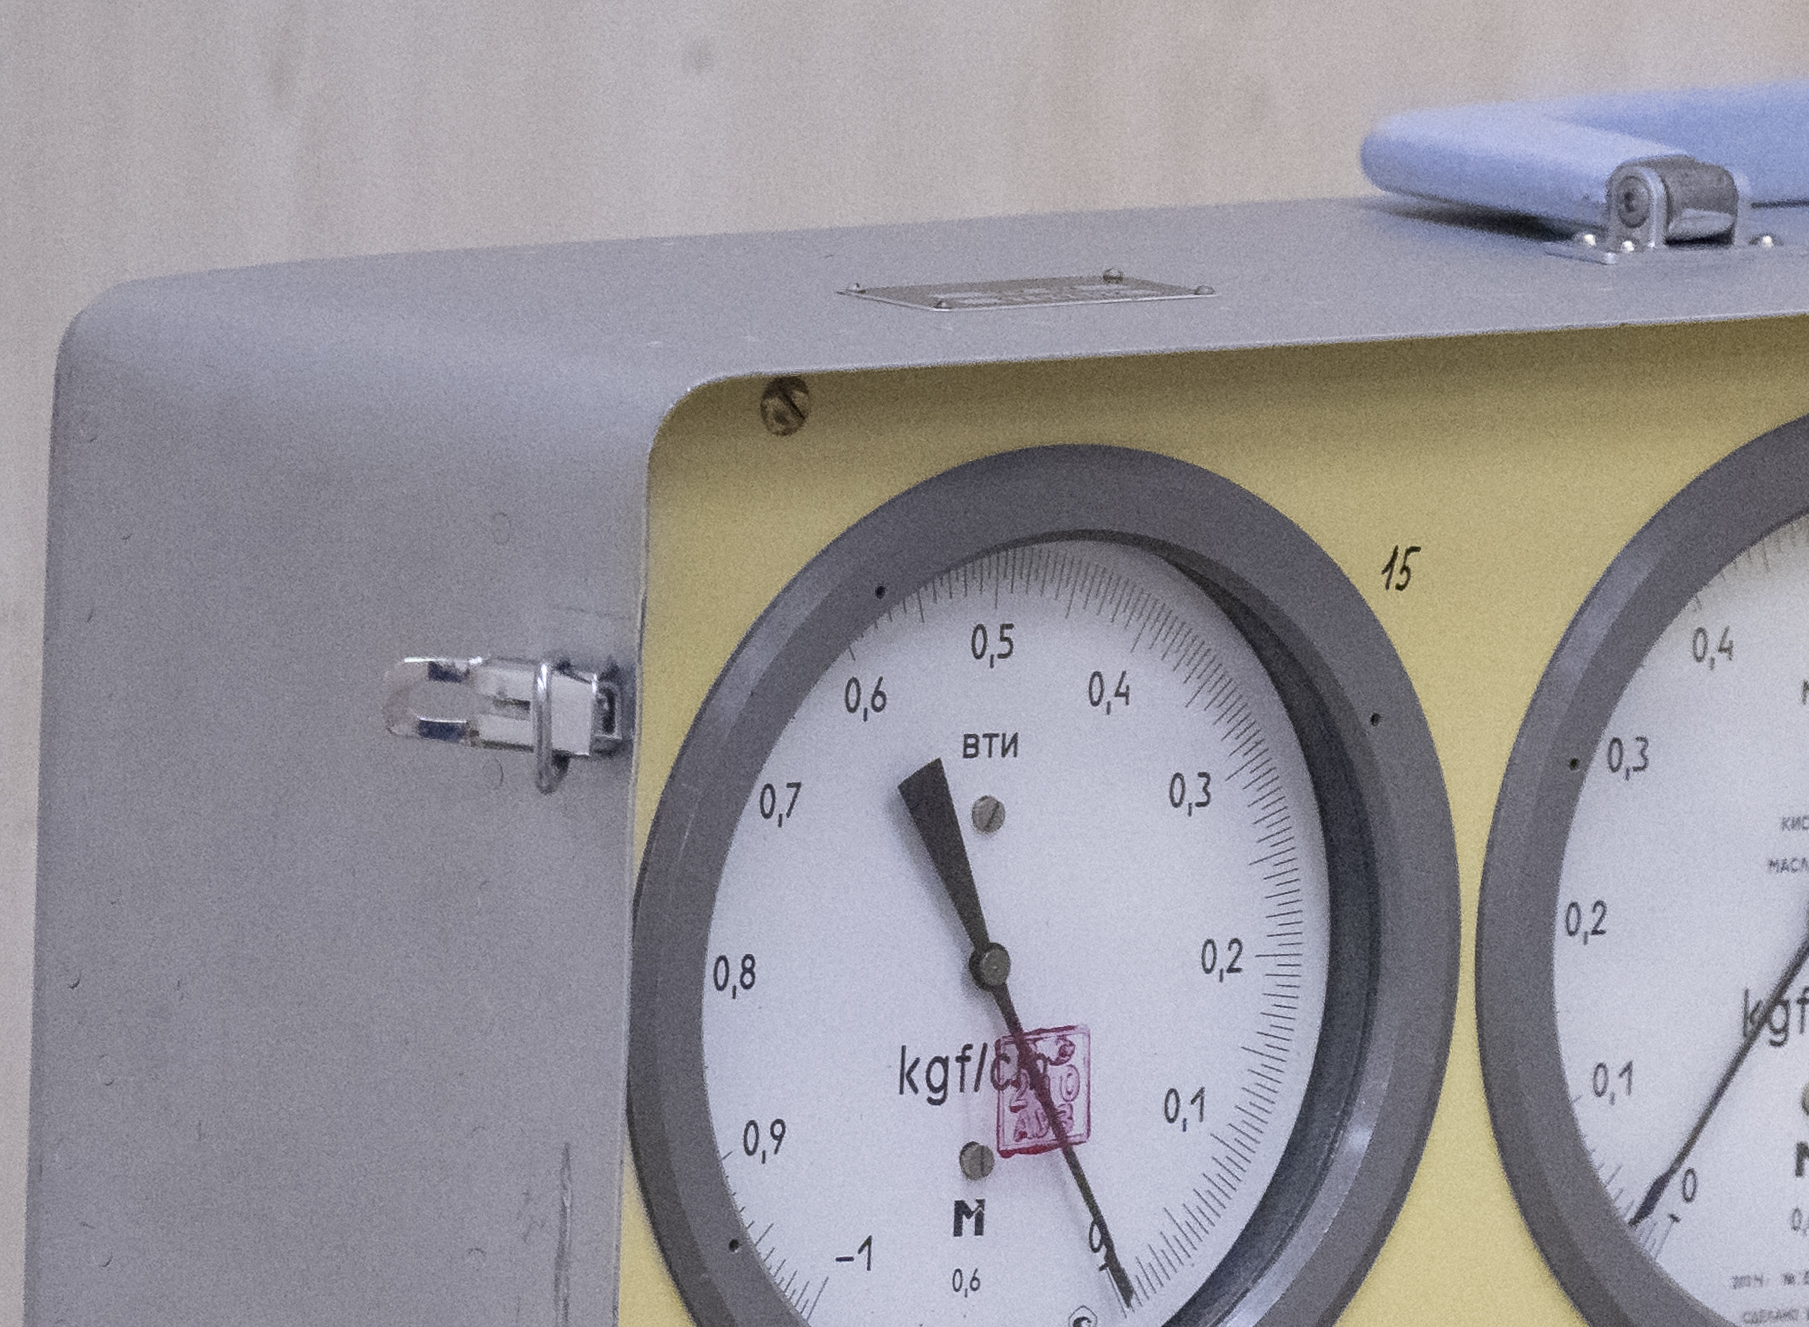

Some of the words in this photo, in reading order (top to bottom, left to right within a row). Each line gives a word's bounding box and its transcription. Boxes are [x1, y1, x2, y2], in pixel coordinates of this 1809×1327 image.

[1381, 545, 1422, 592] 15
[970, 622, 1015, 669] 0,5
[1691, 626, 1734, 671] 0,4
[843, 676, 888, 723] 0,6
[1087, 670, 1131, 716] 0,4
[962, 732, 1019, 760] ВТИ
[1606, 735, 1649, 781] 0,3
[758, 781, 803, 828] 0,7
[1168, 771, 1212, 817] 0,3
[1564, 899, 1607, 946] 0,2
[712, 953, 756, 1000] 0,8
[1200, 937, 1244, 983] 0,2
[1591, 1060, 1634, 1106] 0,1
[1163, 1086, 1206, 1133] 0,1
[742, 1118, 787, 1165] 0,9
[1680, 1167, 1698, 1204] 0
[951, 1267, 982, 1298] 0,6
